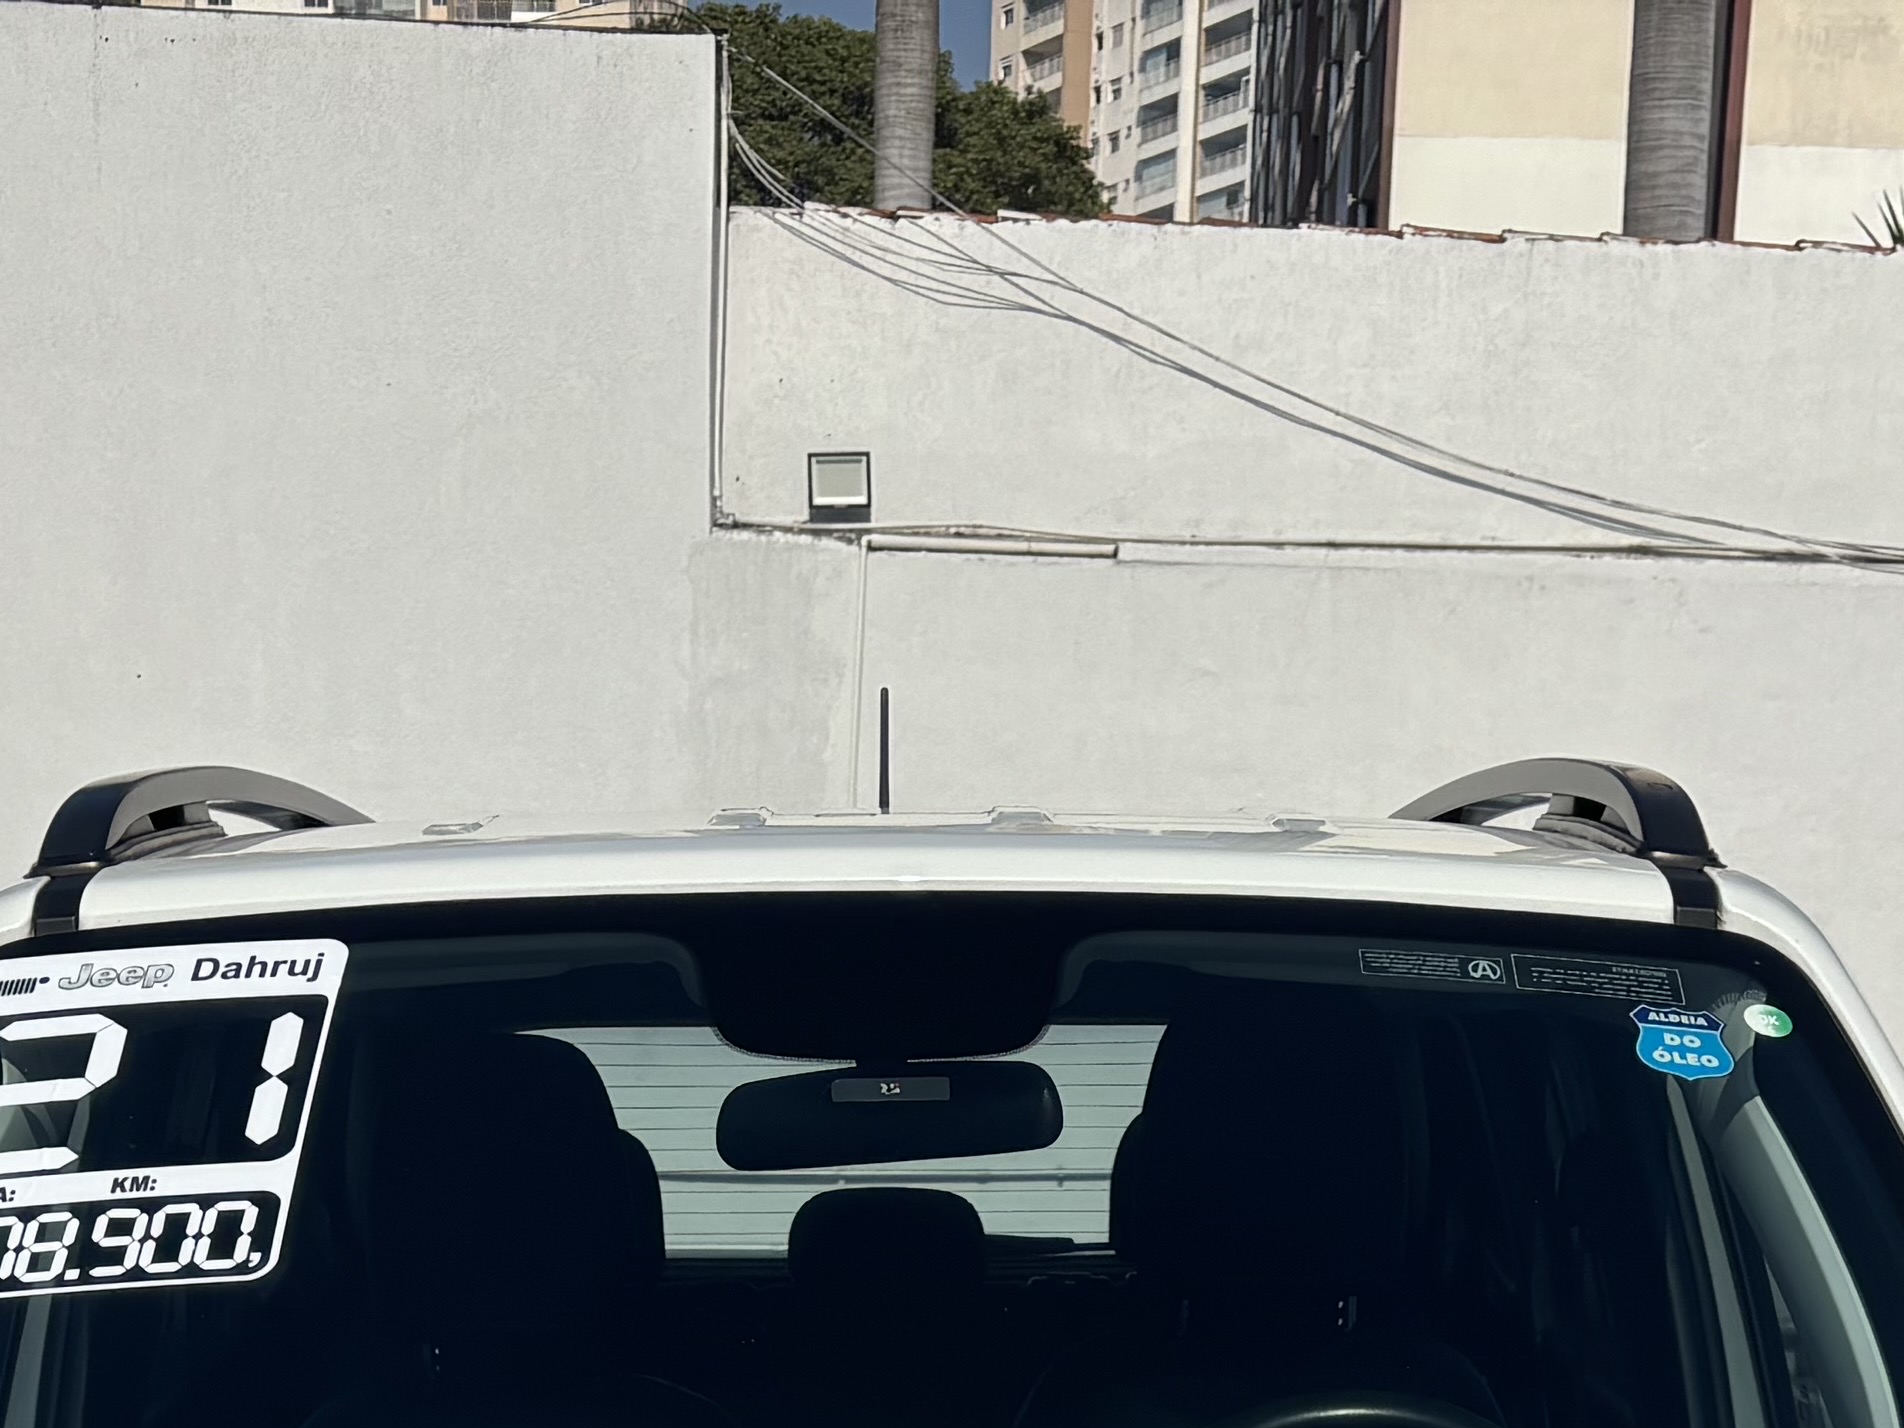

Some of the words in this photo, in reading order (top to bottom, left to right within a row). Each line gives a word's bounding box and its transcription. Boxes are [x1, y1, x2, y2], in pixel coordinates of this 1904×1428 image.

[58, 963, 175, 990] Jeep
[191, 952, 325, 983] Dahruj
[1647, 1011, 1709, 1027] ALDEIA
[1663, 1032, 1702, 1048] DO
[1652, 1046, 1720, 1068] ÓLEO
[110, 1175, 157, 1194] KM:
